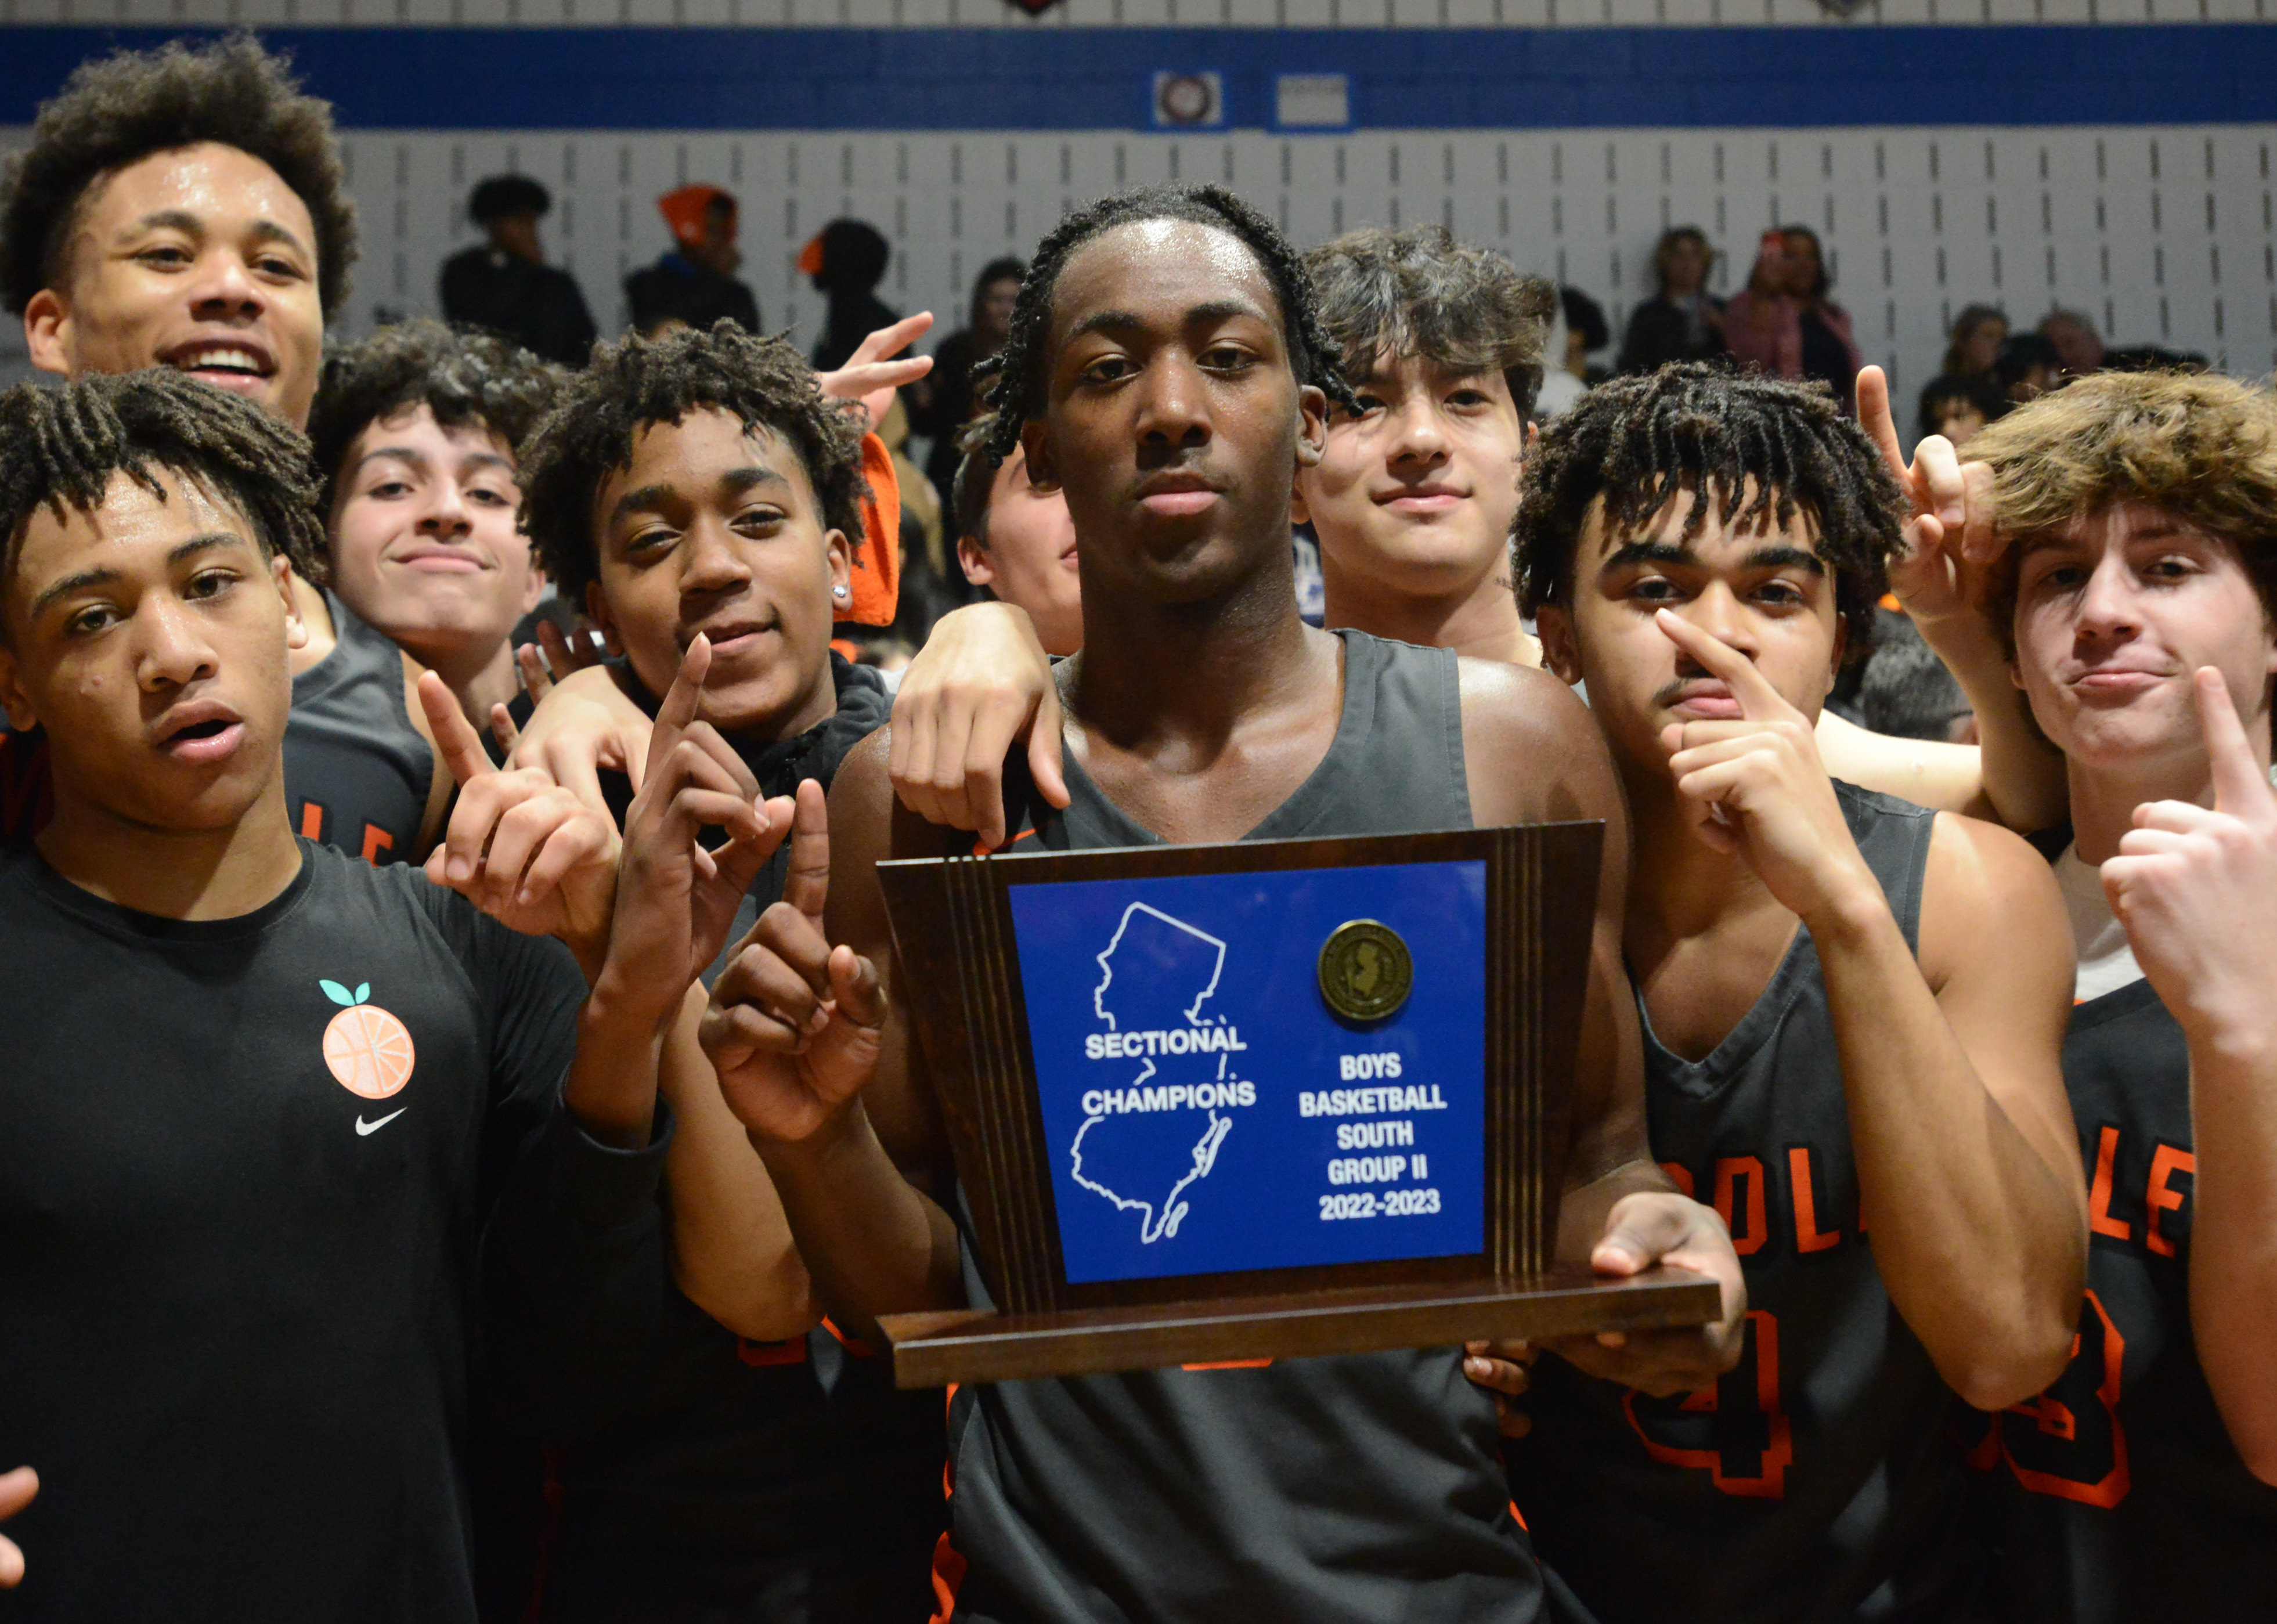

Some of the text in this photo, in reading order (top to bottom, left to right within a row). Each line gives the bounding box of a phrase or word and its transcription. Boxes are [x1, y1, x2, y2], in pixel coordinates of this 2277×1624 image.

[1085, 1026, 1247, 1060] SECTIONAL
[1340, 1052, 1402, 1081] BOYS
[1081, 1081, 1257, 1116] CHAMPIONS
[1299, 1084, 1448, 1117] BASKETBALL
[1337, 1120, 1414, 1150] SOUTH
[1327, 1154, 1428, 1185] GROUP II
[1319, 1189, 1441, 1221] 2022-2023
